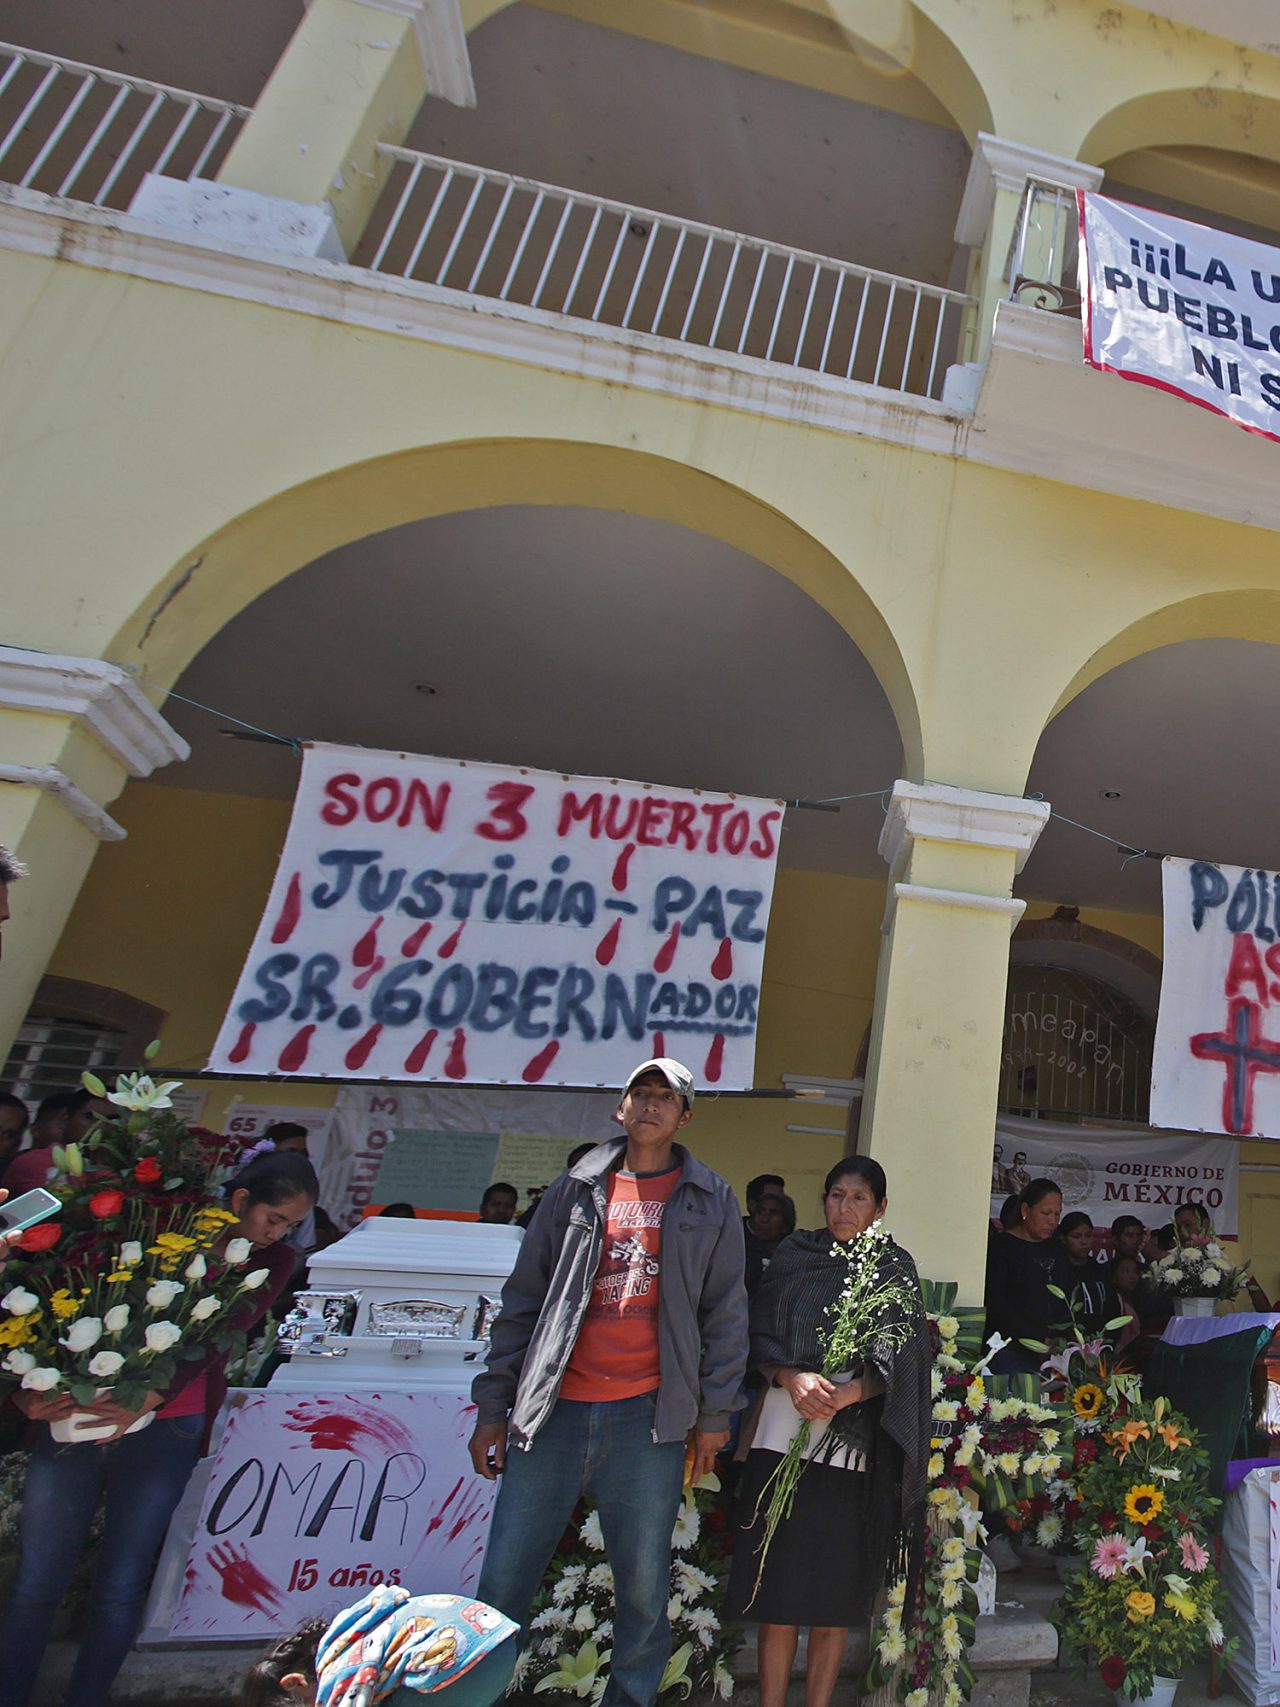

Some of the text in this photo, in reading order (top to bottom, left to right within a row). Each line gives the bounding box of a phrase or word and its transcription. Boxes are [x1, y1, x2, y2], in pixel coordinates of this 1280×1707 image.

[1191, 345, 1241, 398] NI
[321, 773, 783, 859] SON 3 MUERTOS
[1004, 1011, 1125, 1086] meapan
[229, 1116, 258, 1133] 65
[1105, 1161, 1225, 1181] GOBIERNO DE
[1102, 1177, 1224, 1208] MÉXICO
[601, 1276, 653, 1306] RACING
[206, 1452, 427, 1546] OMAR
[287, 1558, 402, 1593] 15 años
